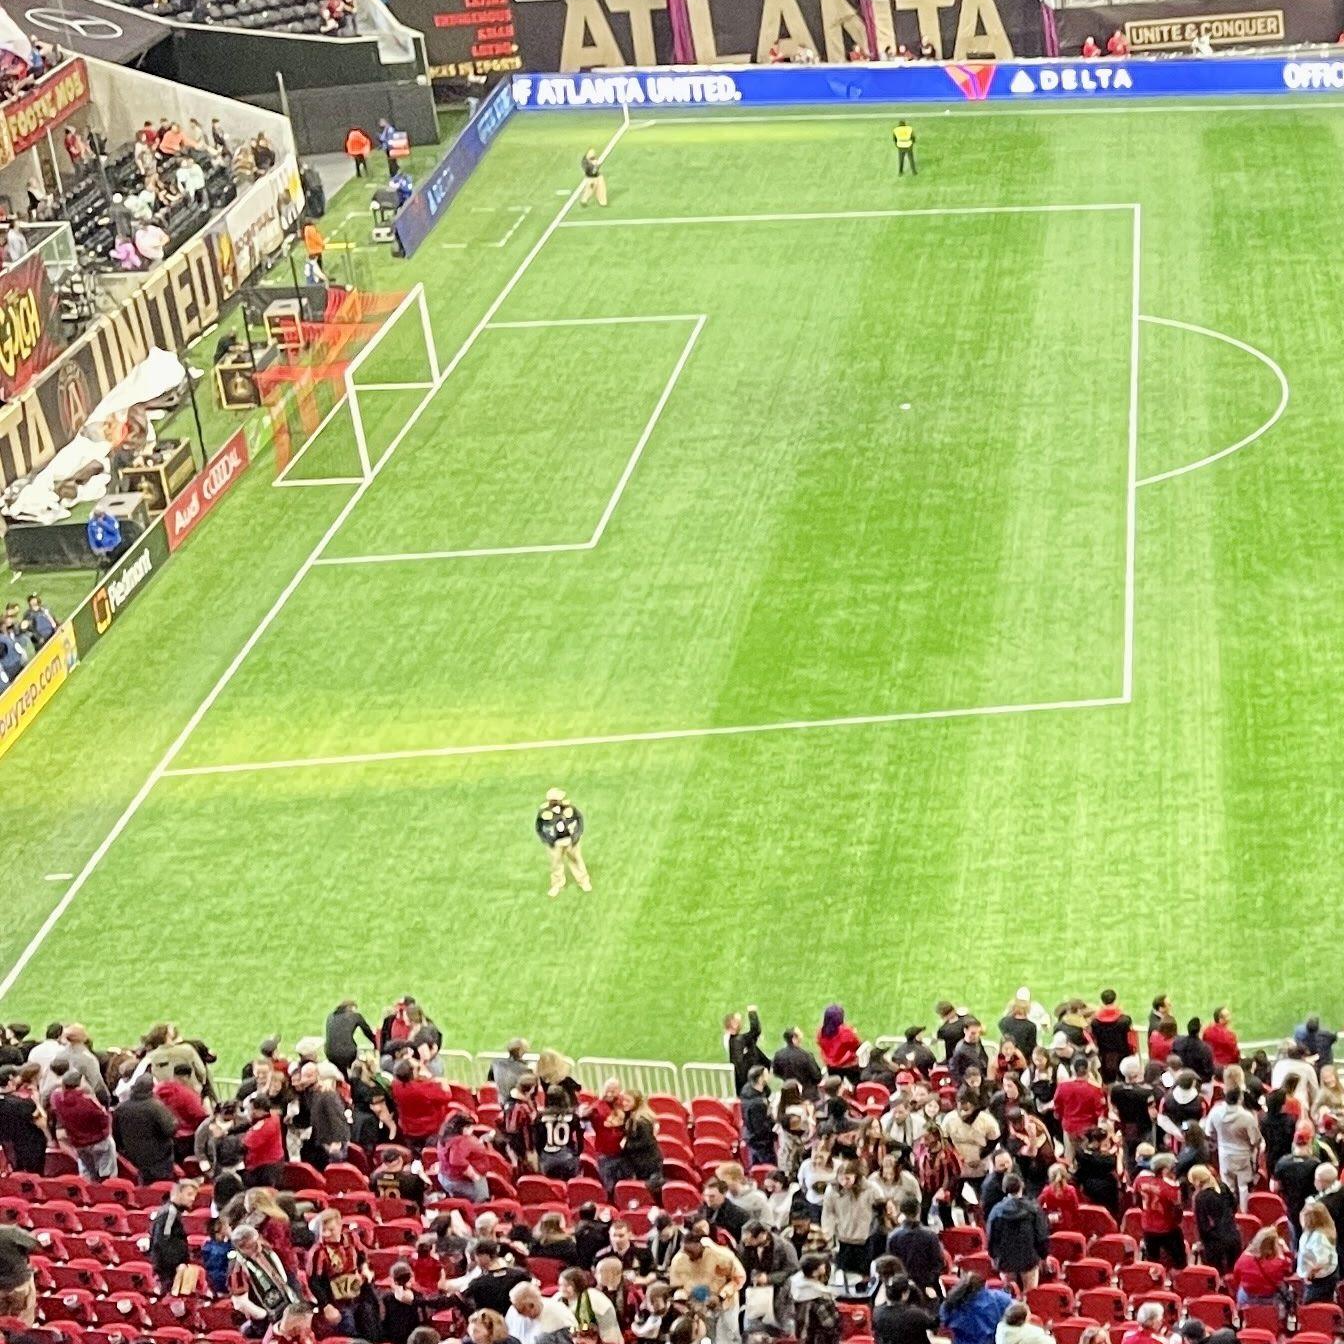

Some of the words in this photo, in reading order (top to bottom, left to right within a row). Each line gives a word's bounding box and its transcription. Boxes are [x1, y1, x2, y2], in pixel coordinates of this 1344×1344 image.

[1131, 23, 1181, 44] UNITE
[1200, 16, 1278, 37] CONQUER
[537, 77, 645, 105] ATLANTA
[1040, 68, 1132, 91] DELTA
[90, 241, 219, 400] UNITED
[175, 492, 200, 535] Audi
[107, 547, 153, 614] Piedmont
[545, 1121, 570, 1148] 10
